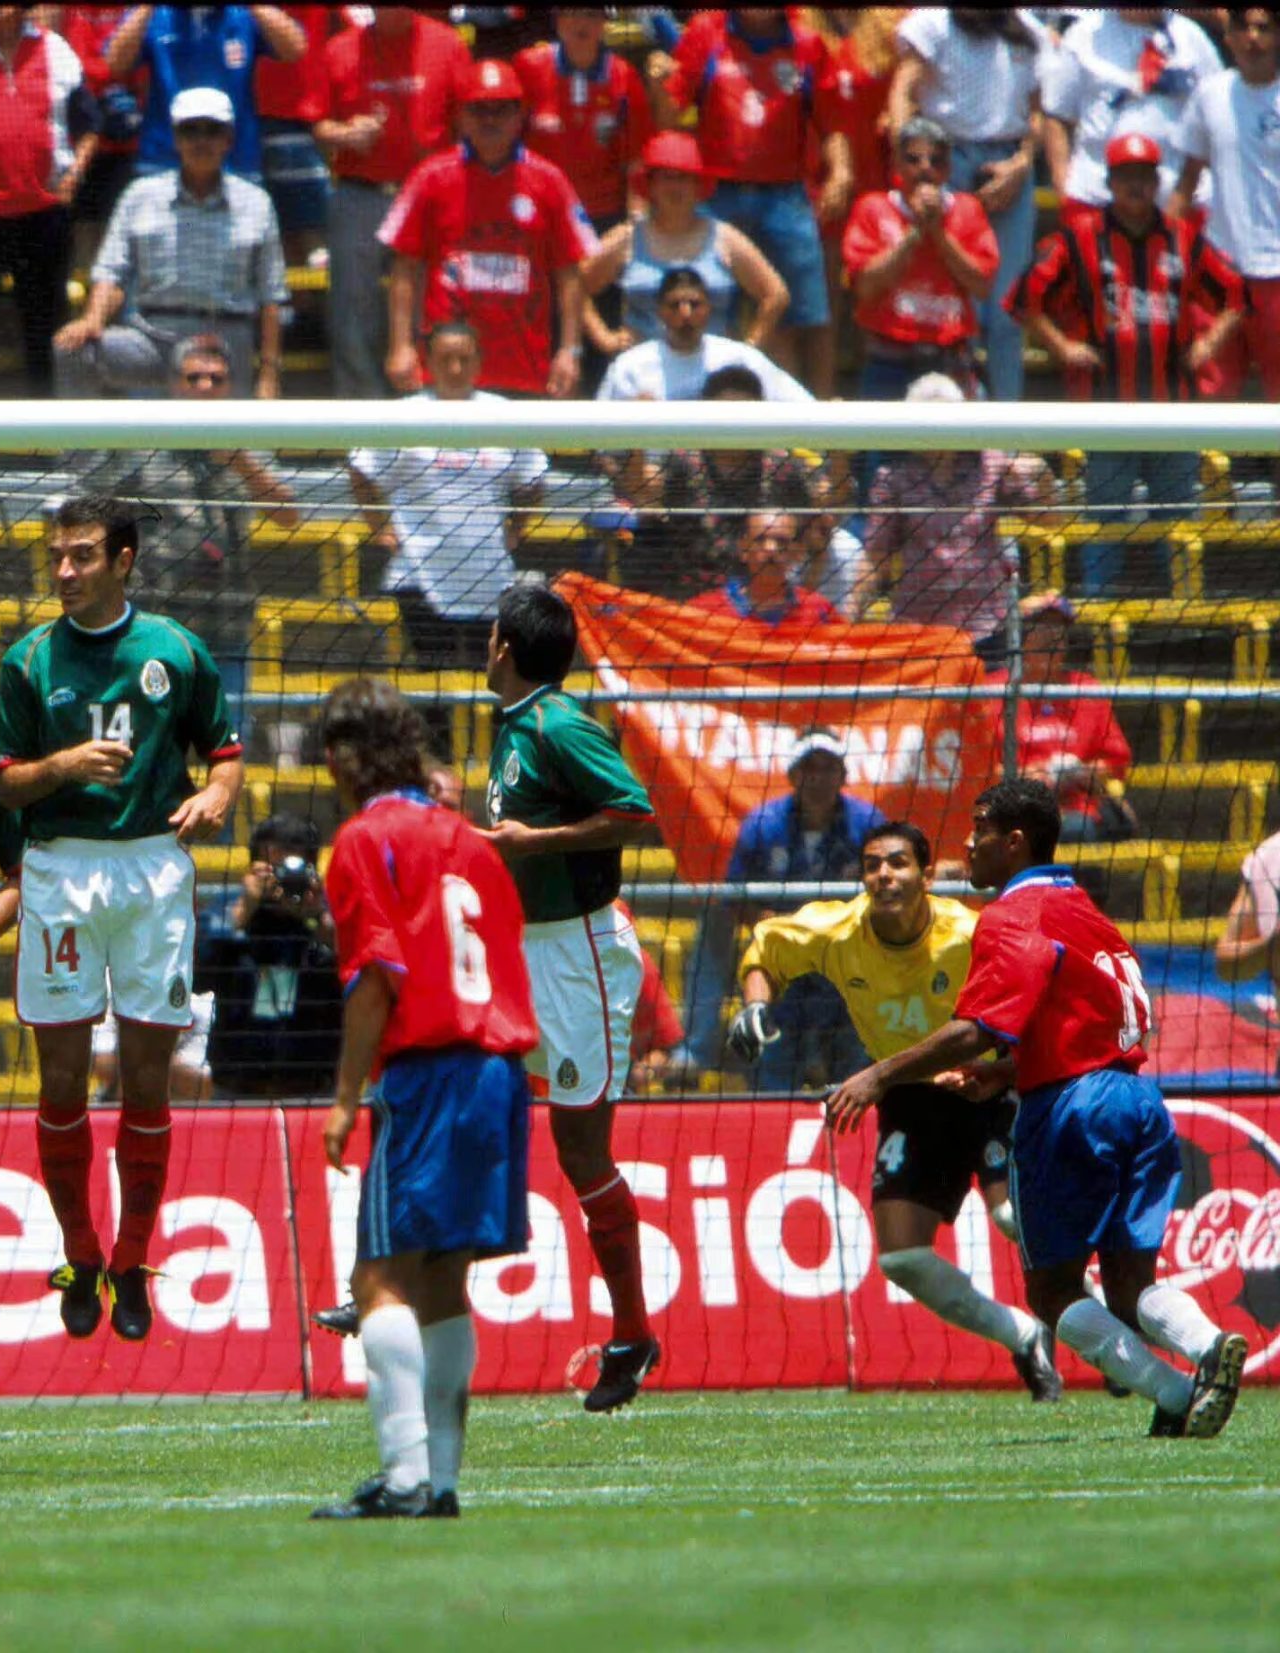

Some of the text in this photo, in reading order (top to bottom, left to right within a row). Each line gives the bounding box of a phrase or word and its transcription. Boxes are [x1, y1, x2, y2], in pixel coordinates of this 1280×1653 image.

[88, 703, 133, 748] 14
[42, 926, 81, 974] 14
[440, 873, 493, 1005] 6
[876, 996, 929, 1034] 24
[108, 1147, 270, 1331] a
